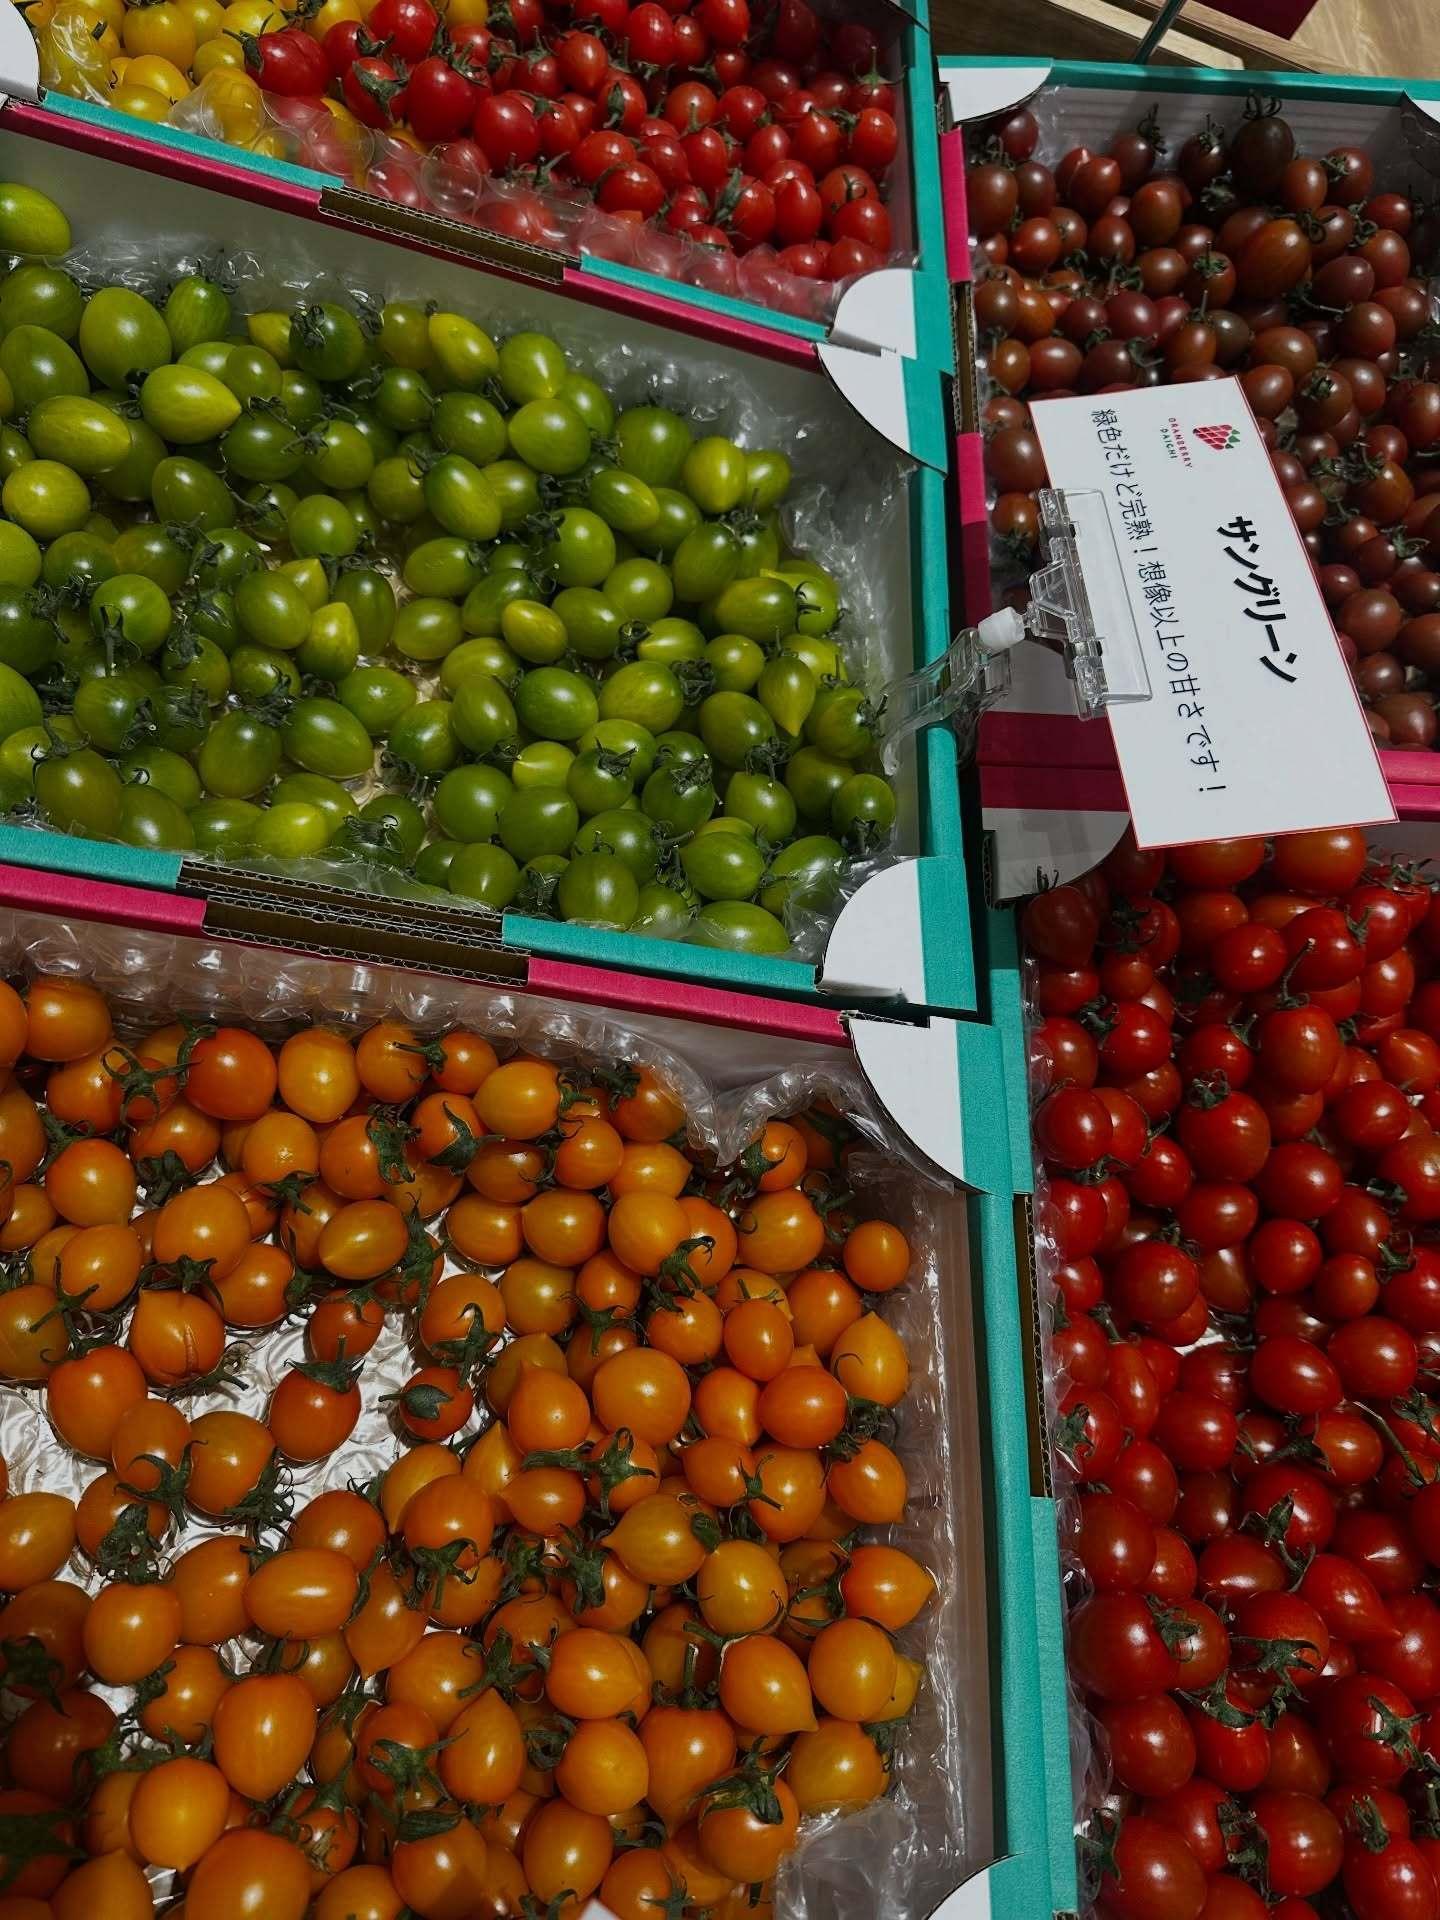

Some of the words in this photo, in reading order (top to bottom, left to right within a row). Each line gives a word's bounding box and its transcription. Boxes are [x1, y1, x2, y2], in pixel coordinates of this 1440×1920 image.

[1217, 516, 1298, 683] サングリーン
